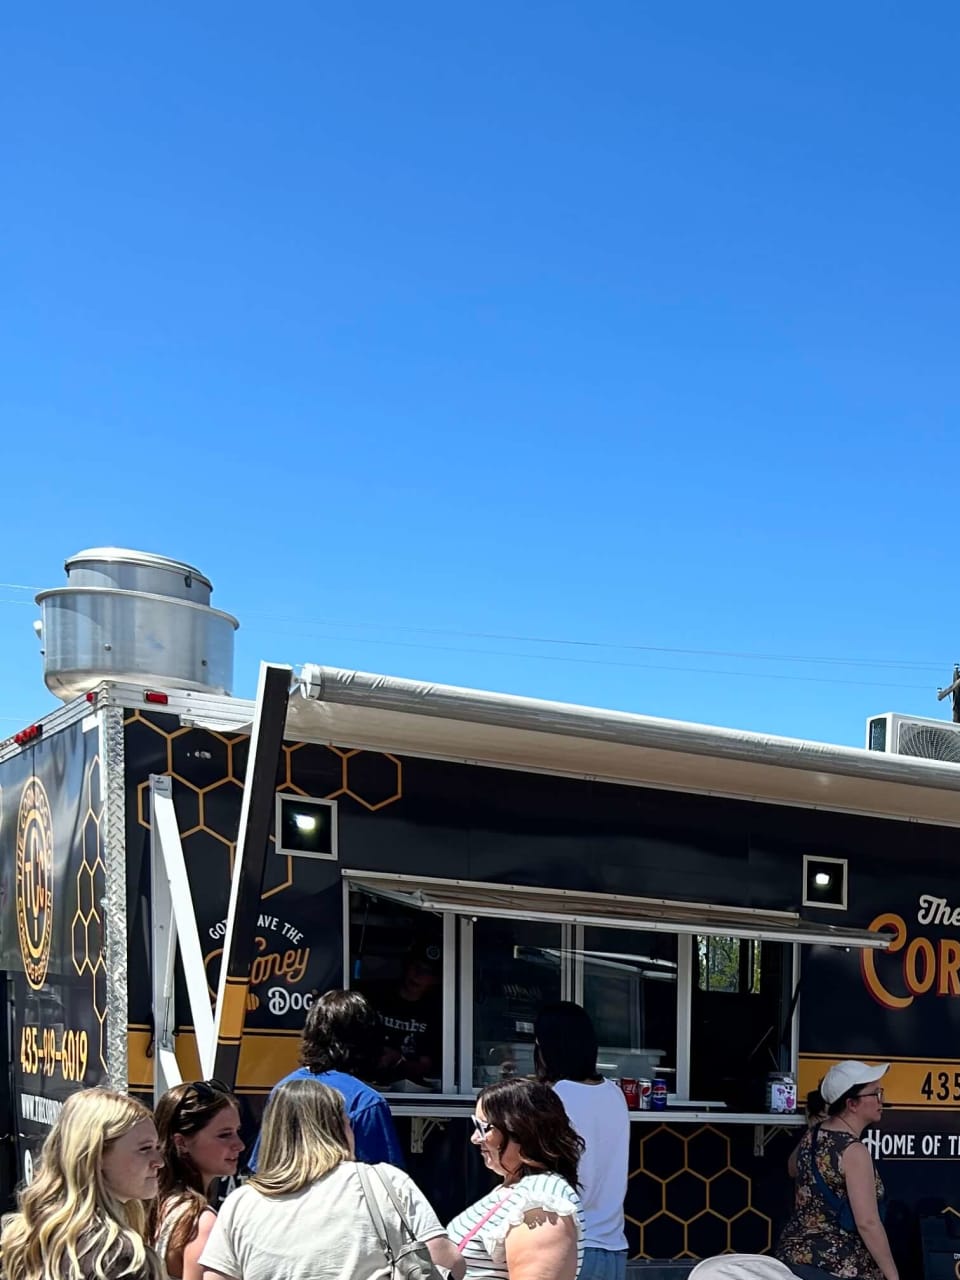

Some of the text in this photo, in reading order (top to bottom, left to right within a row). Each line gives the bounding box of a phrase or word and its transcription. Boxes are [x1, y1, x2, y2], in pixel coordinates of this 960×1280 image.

[281, 922, 304, 945] THE
[267, 986, 313, 1016] DOG
[861, 1129, 916, 1160] HOME
[921, 1134, 942, 1156] OF
